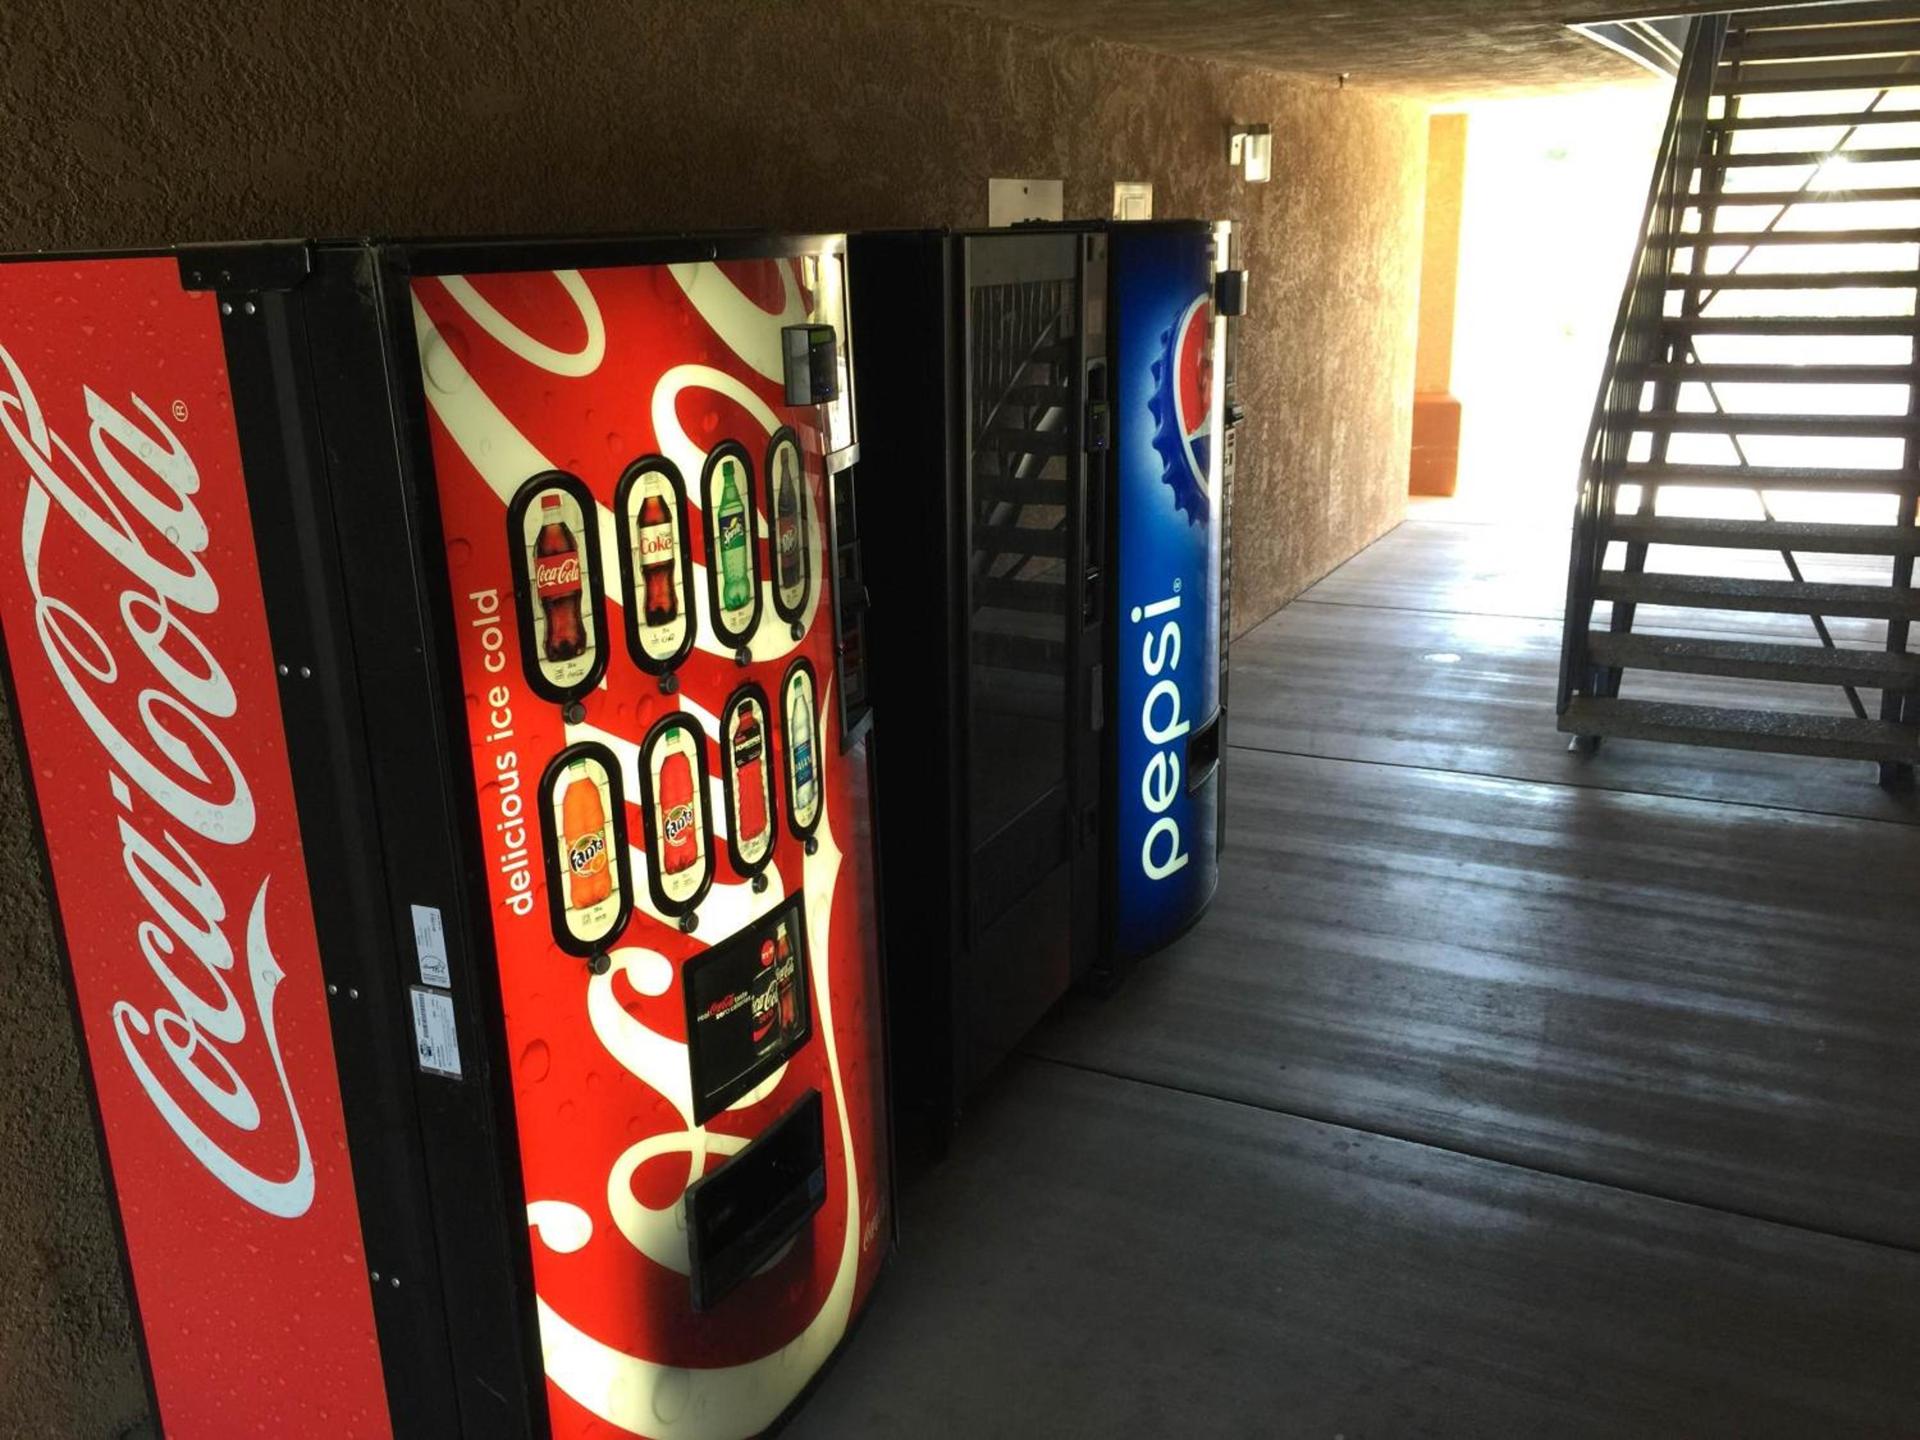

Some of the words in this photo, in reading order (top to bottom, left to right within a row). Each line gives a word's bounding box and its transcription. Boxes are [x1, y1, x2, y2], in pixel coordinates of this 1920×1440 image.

[640, 535, 673, 556] Coke
[469, 588, 506, 673] cold
[486, 685, 514, 742] ice
[1131, 595, 1190, 880] pepsi
[497, 750, 534, 916] delicious
[665, 808, 693, 841] Fanta
[570, 838, 604, 873] Fanta
